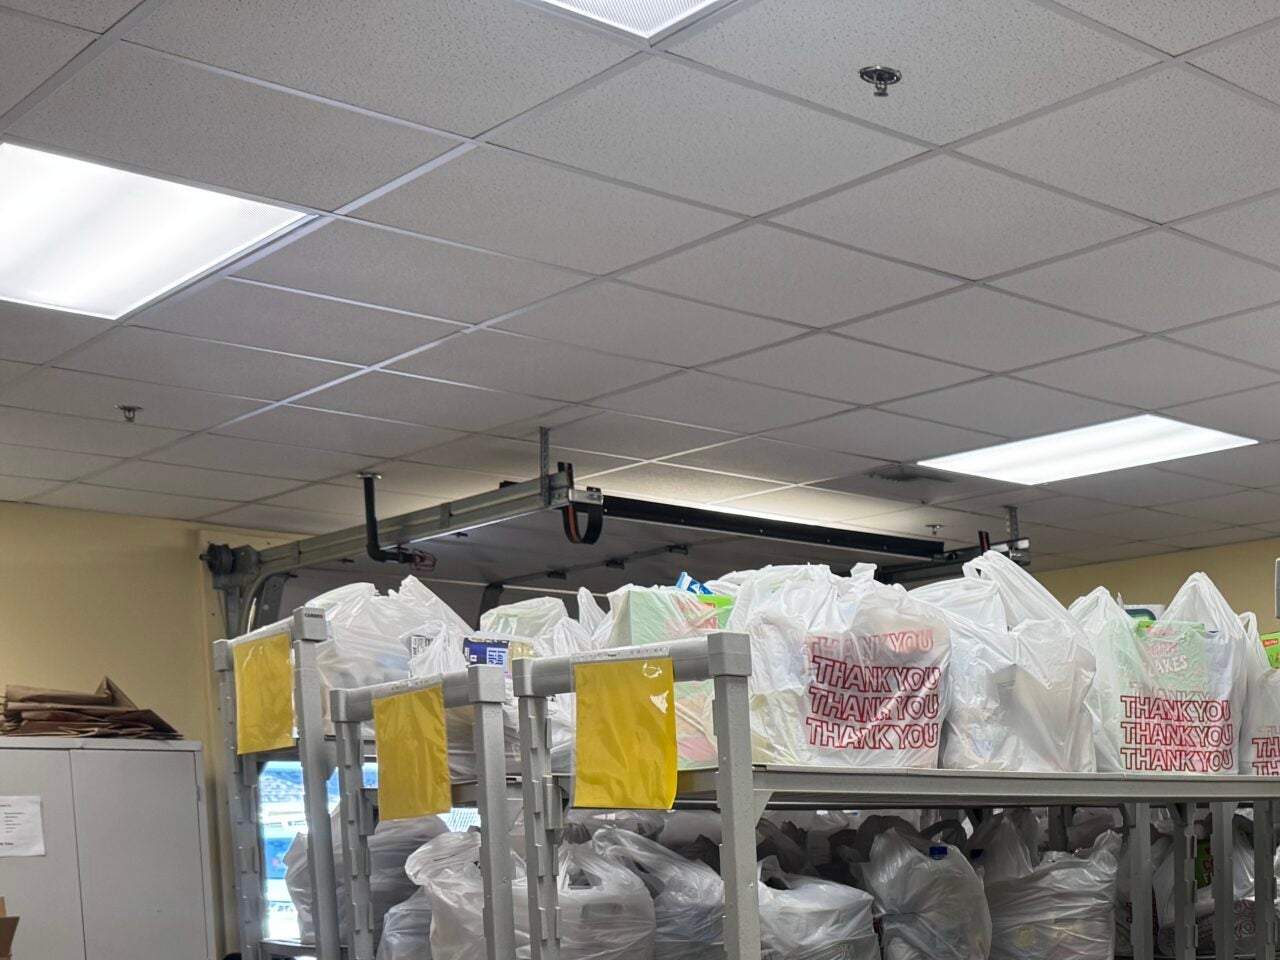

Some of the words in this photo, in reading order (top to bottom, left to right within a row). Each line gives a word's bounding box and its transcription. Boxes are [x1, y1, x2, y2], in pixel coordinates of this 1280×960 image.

[888, 630, 934, 653] YOU
[812, 655, 893, 692] THANK
[894, 667, 941, 691] YOU
[809, 686, 892, 722] THANK
[893, 694, 939, 720] YOU
[1120, 695, 1193, 721] THANK
[1193, 700, 1232, 722] YOU
[806, 717, 893, 750] THANK
[893, 723, 938, 750] YOU
[1120, 722, 1195, 746] THANK
[1195, 724, 1233, 747] YOU
[1120, 748, 1196, 771] THANK
[1196, 749, 1233, 772] YOU
